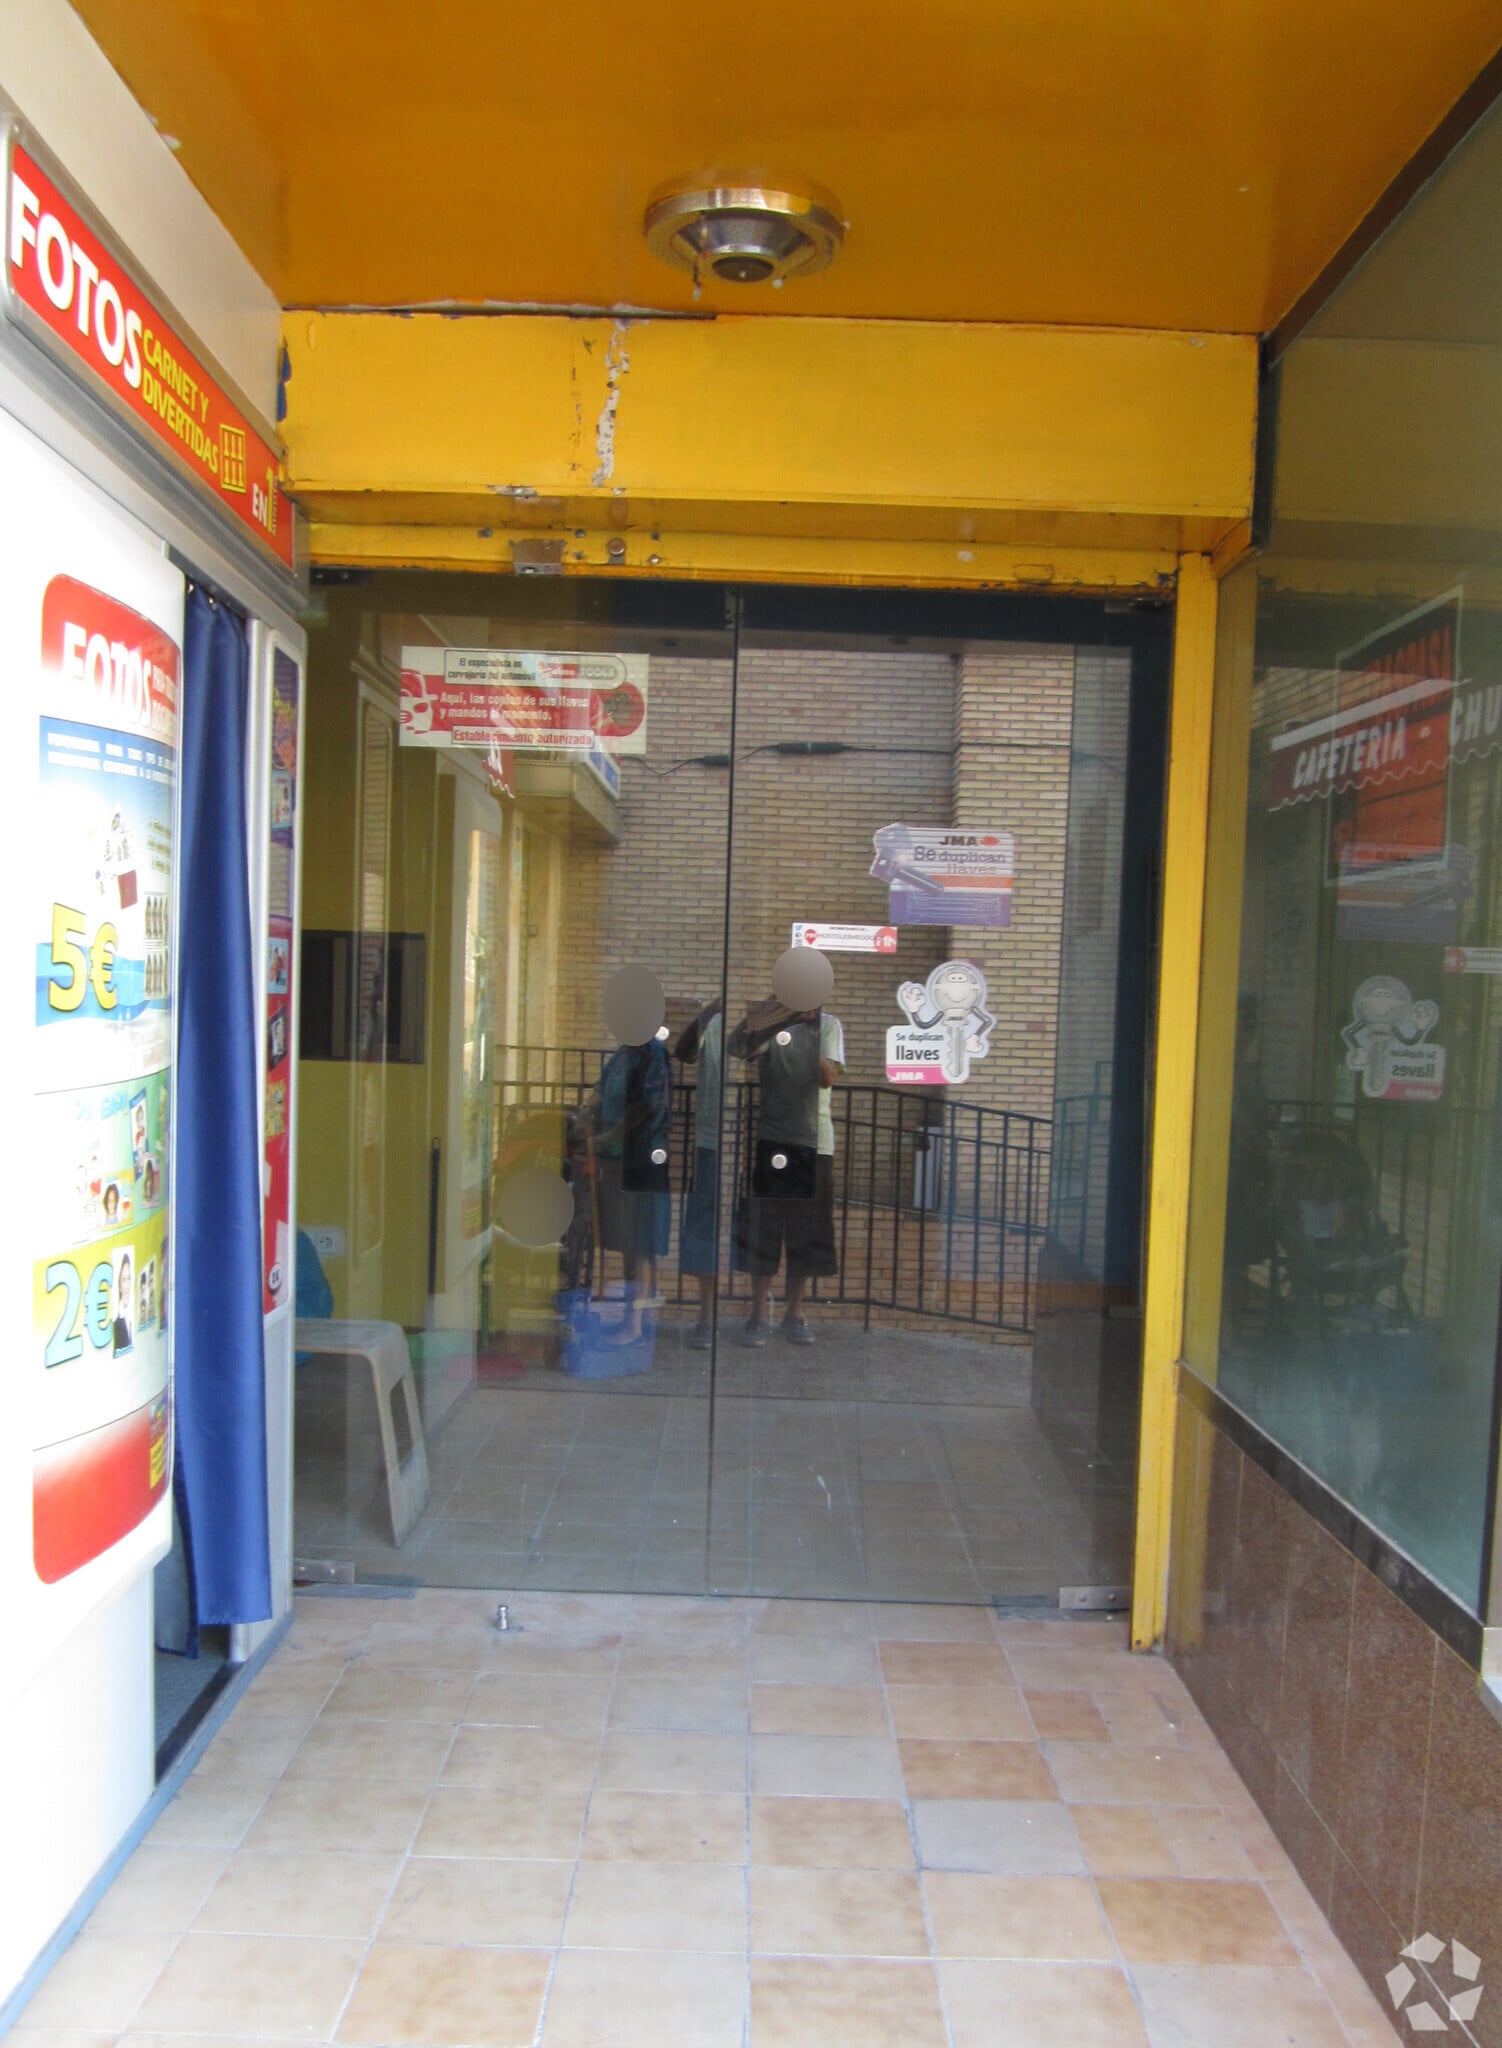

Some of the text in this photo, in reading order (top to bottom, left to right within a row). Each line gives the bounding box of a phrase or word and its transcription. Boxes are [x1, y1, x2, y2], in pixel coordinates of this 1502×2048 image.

[11, 171, 142, 389] FOTOS
[143, 329, 209, 423] CARNET Y
[143, 368, 219, 474] DIVERTIDAS
[252, 466, 274, 533] EN 1
[63, 620, 152, 728] FOTOS
[470, 692, 485, 704] las
[488, 693, 522, 706] copias
[523, 693, 536, 706] de
[538, 696, 555, 707] sus
[440, 708, 445, 719] y
[448, 707, 488, 719] mandos
[453, 729, 592, 745] Establecimiento autorizado
[1293, 716, 1406, 790] CAFETERIA
[939, 835, 978, 846] JMA
[914, 845, 1006, 864] Se duplican
[946, 863, 997, 875] llaves
[47, 901, 119, 1012] 5€
[896, 1032, 944, 1043] Se duplican
[896, 1045, 940, 1060] llaves
[891, 1071, 925, 1081] JMA
[44, 1259, 113, 1369] 2€
